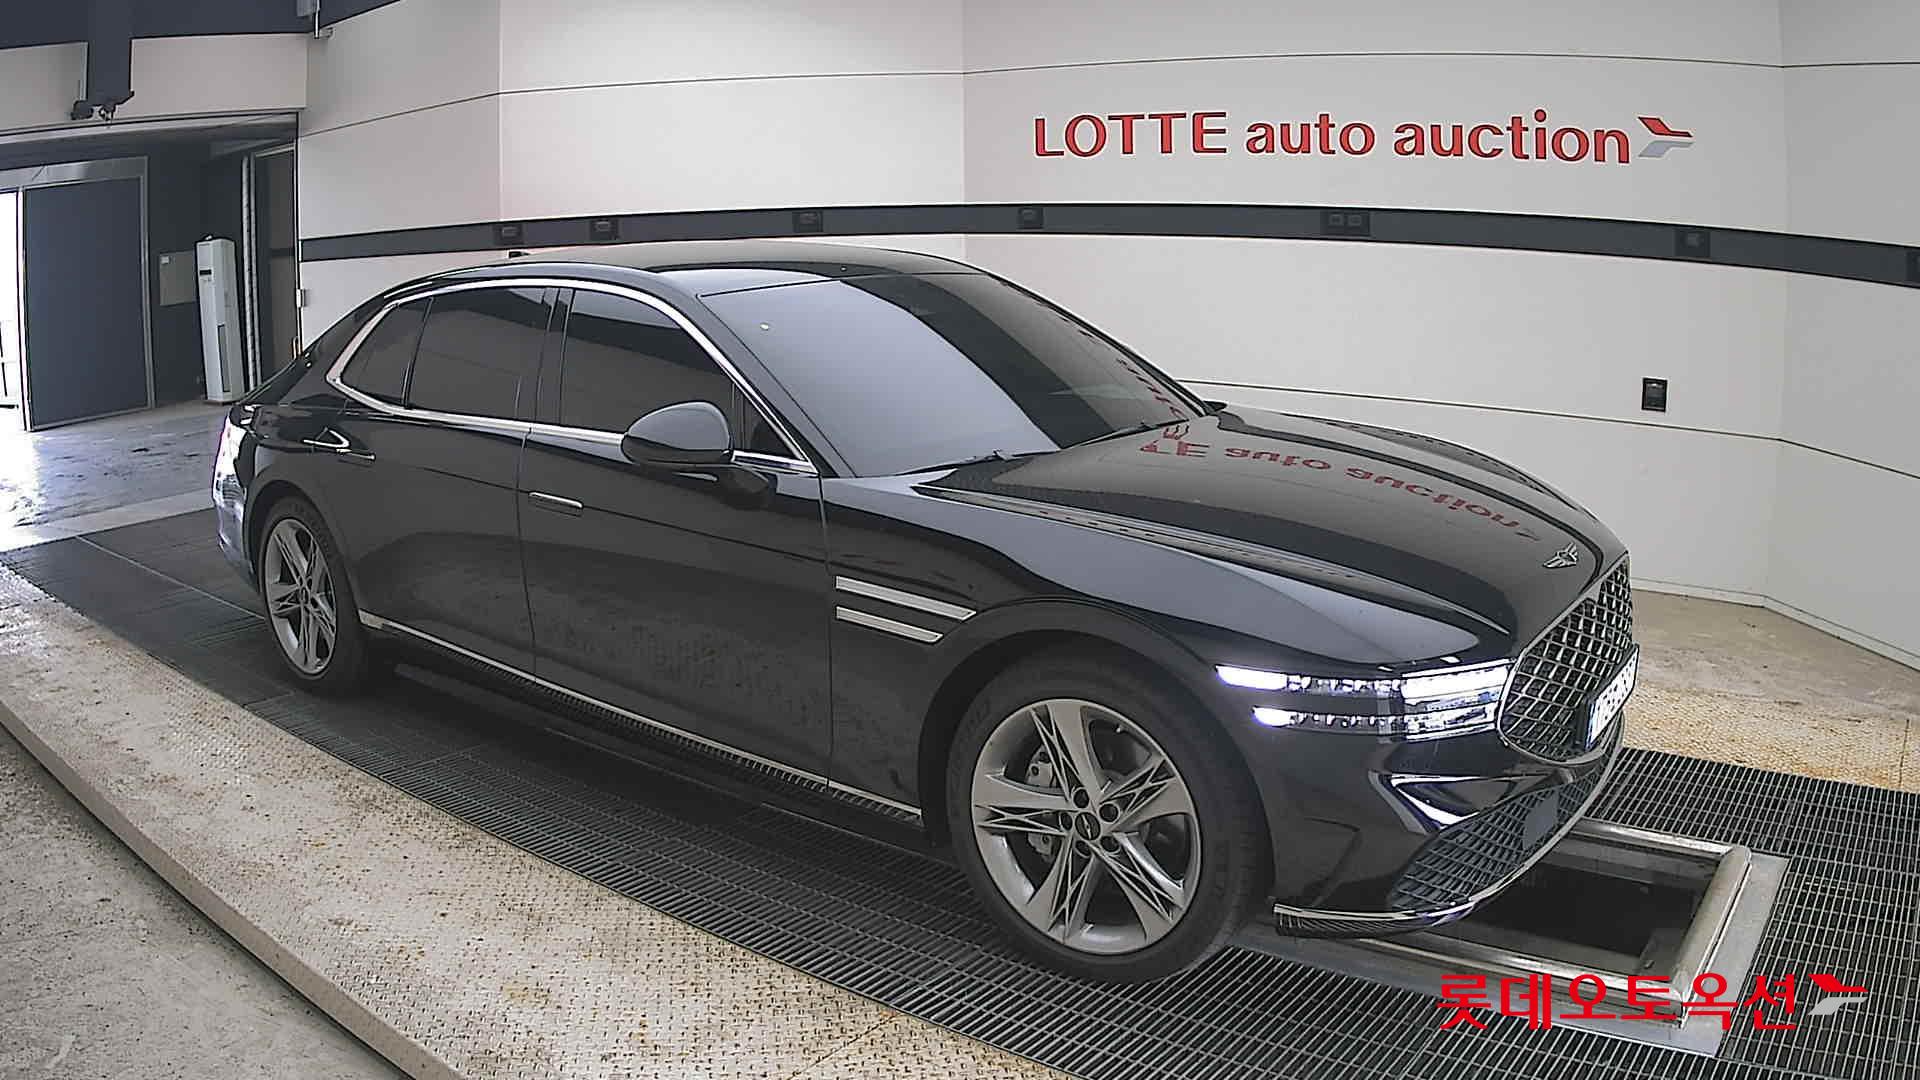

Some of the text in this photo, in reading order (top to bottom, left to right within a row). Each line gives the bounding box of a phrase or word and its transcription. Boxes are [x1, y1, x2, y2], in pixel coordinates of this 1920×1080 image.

[1035, 109, 1631, 164] LOTTE auto auction
